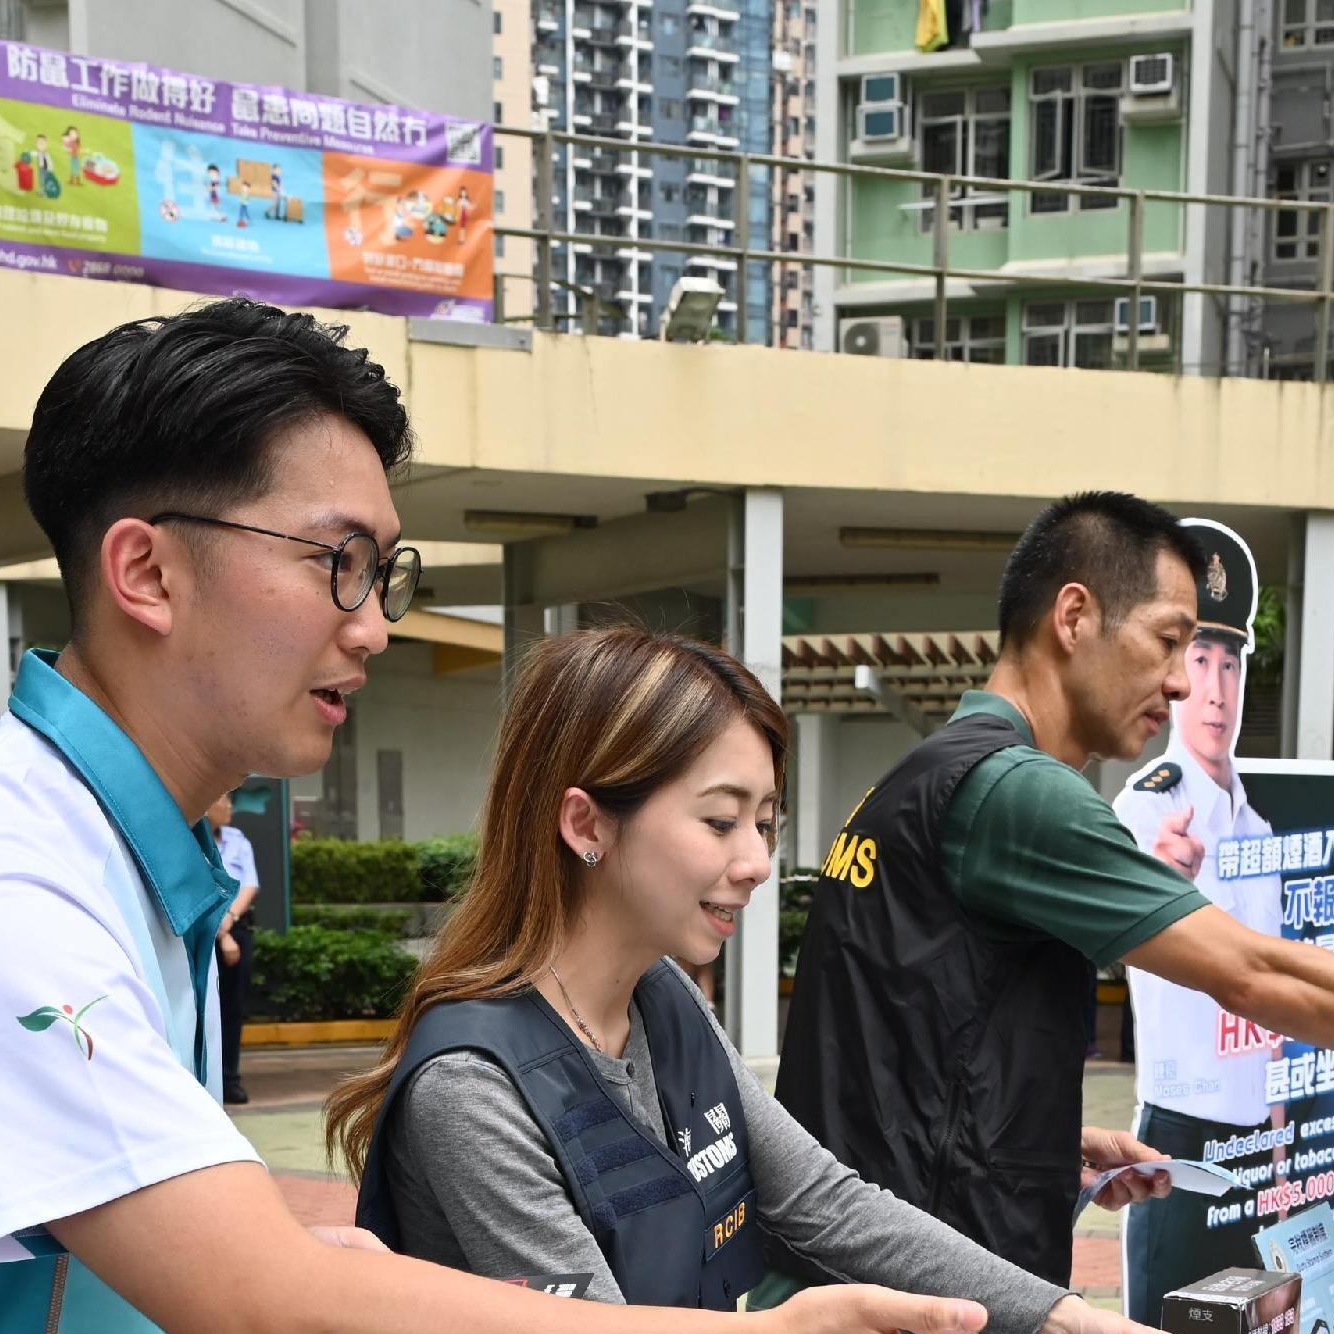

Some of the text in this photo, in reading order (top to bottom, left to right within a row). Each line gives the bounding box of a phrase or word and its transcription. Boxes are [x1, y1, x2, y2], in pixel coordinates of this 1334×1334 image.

[72, 94, 127, 117] Eliminate
[128, 105, 172, 124] Rodent
[232, 122, 258, 138] Take
[260, 126, 322, 147] Preventive
[1202, 1120, 1295, 1164] Undeclared
[1276, 1160, 1291, 1175] or
[1244, 1199, 1254, 1217] a
[1188, 1307, 1214, 1322] 煙支
